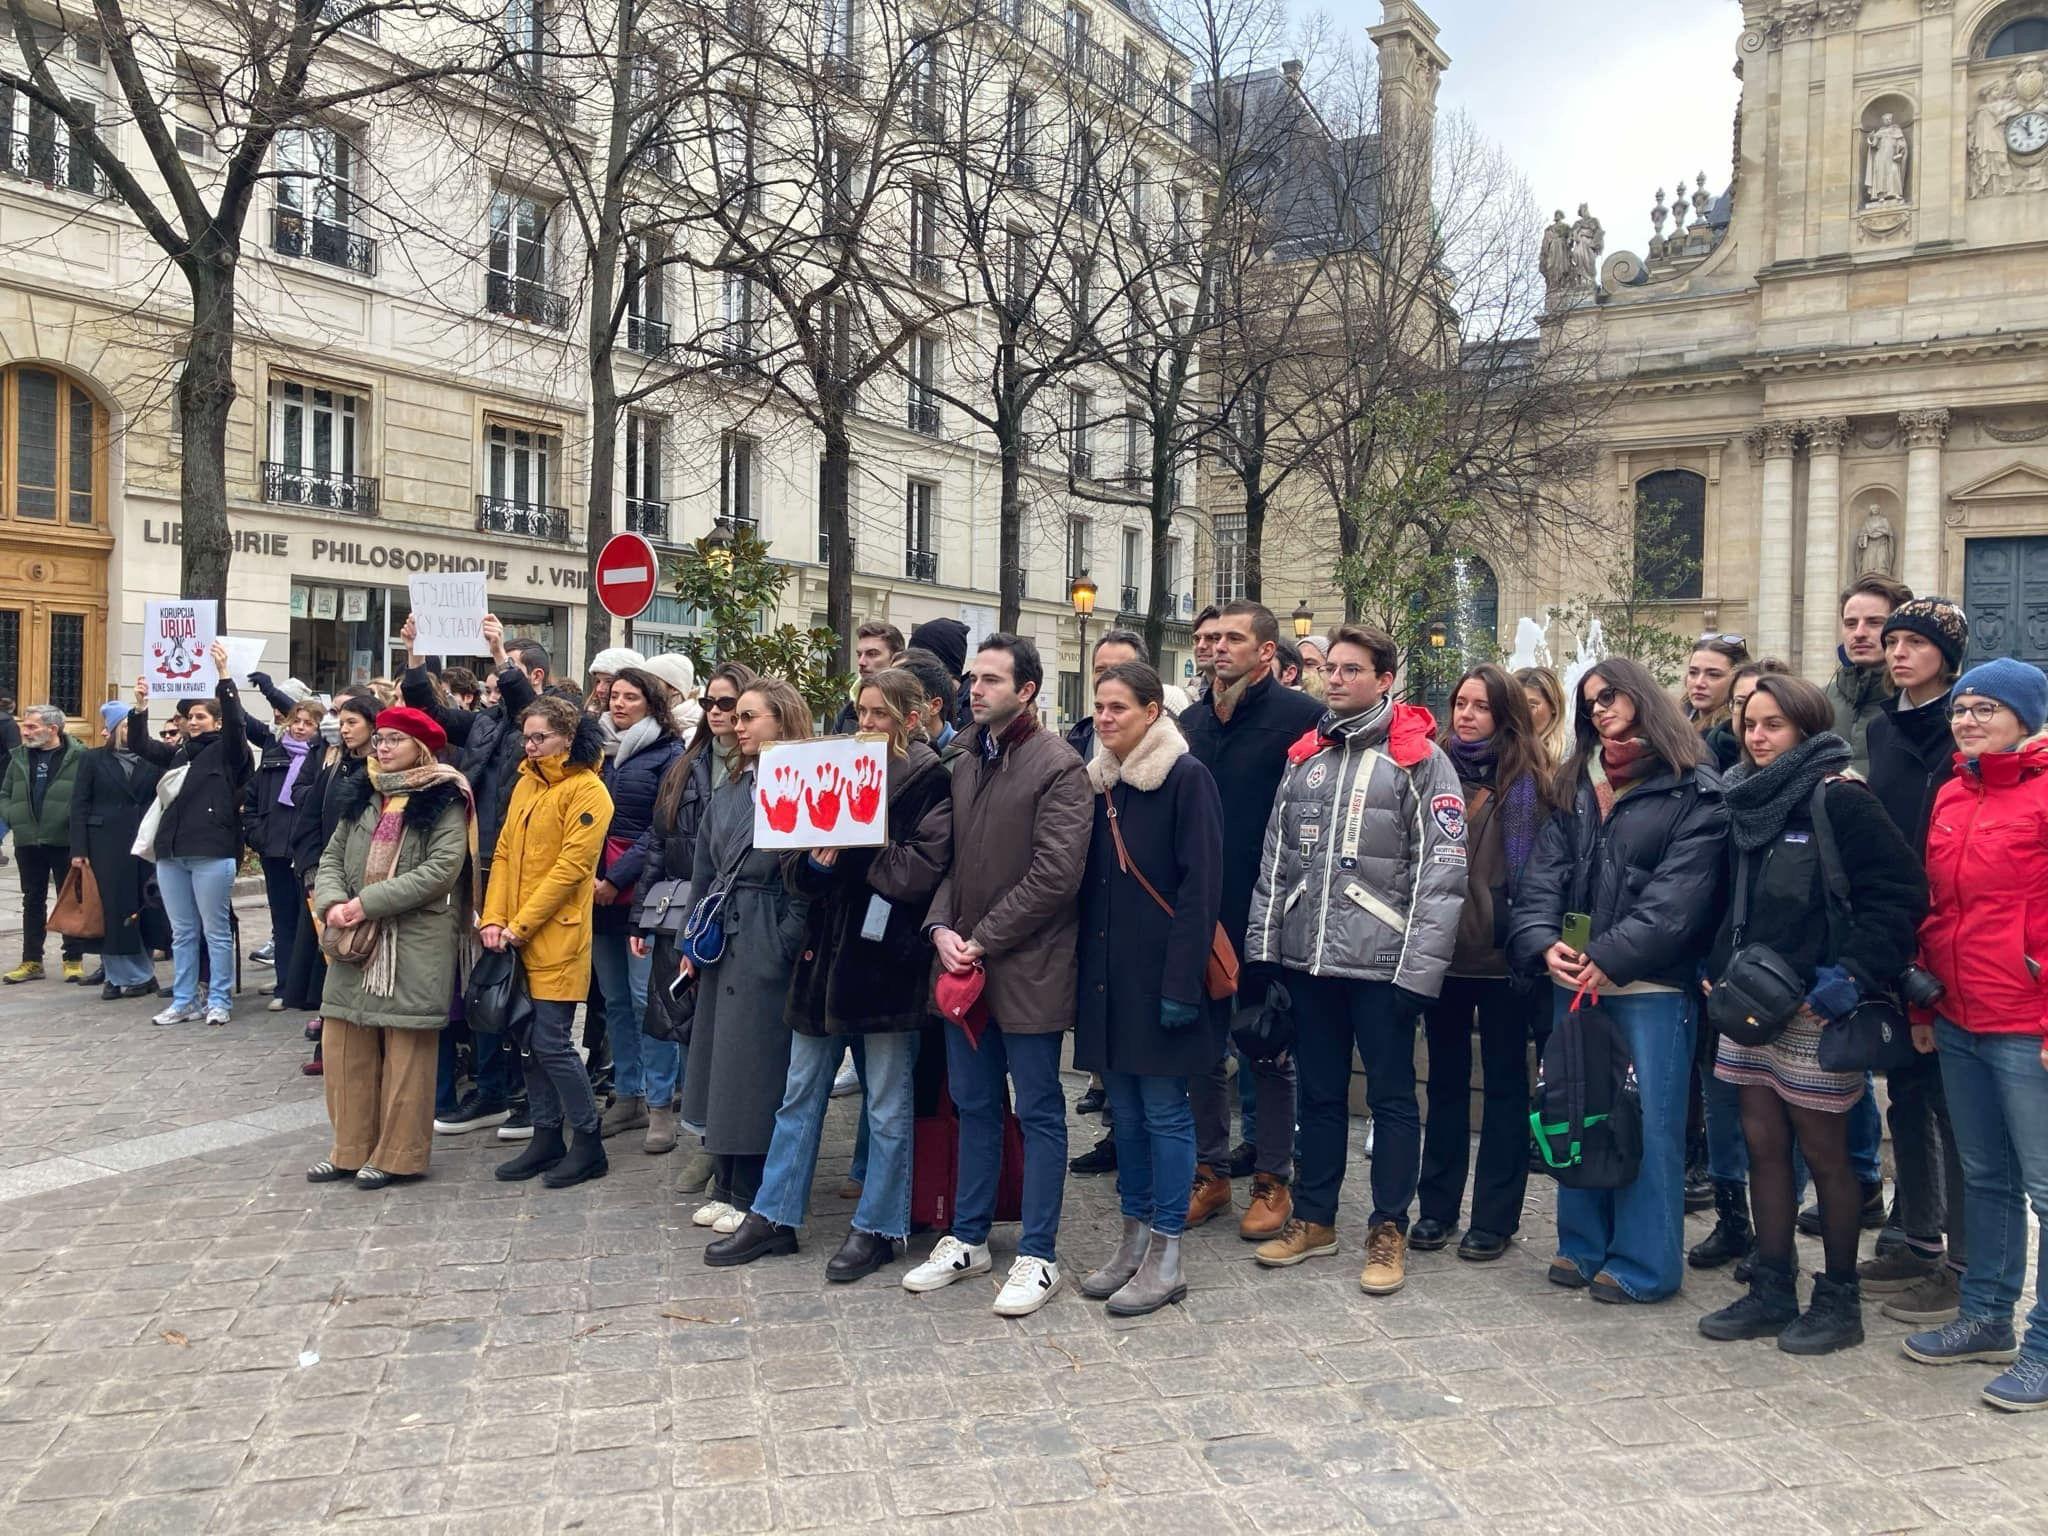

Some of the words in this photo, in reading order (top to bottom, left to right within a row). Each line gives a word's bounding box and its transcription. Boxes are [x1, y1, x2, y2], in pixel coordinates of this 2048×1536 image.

[144, 519, 288, 557] LIBIRIE
[312, 538, 508, 580] PHILOSOPHIQUE
[527, 565, 544, 584] J.
[160, 619, 197, 639] UBIJA!
